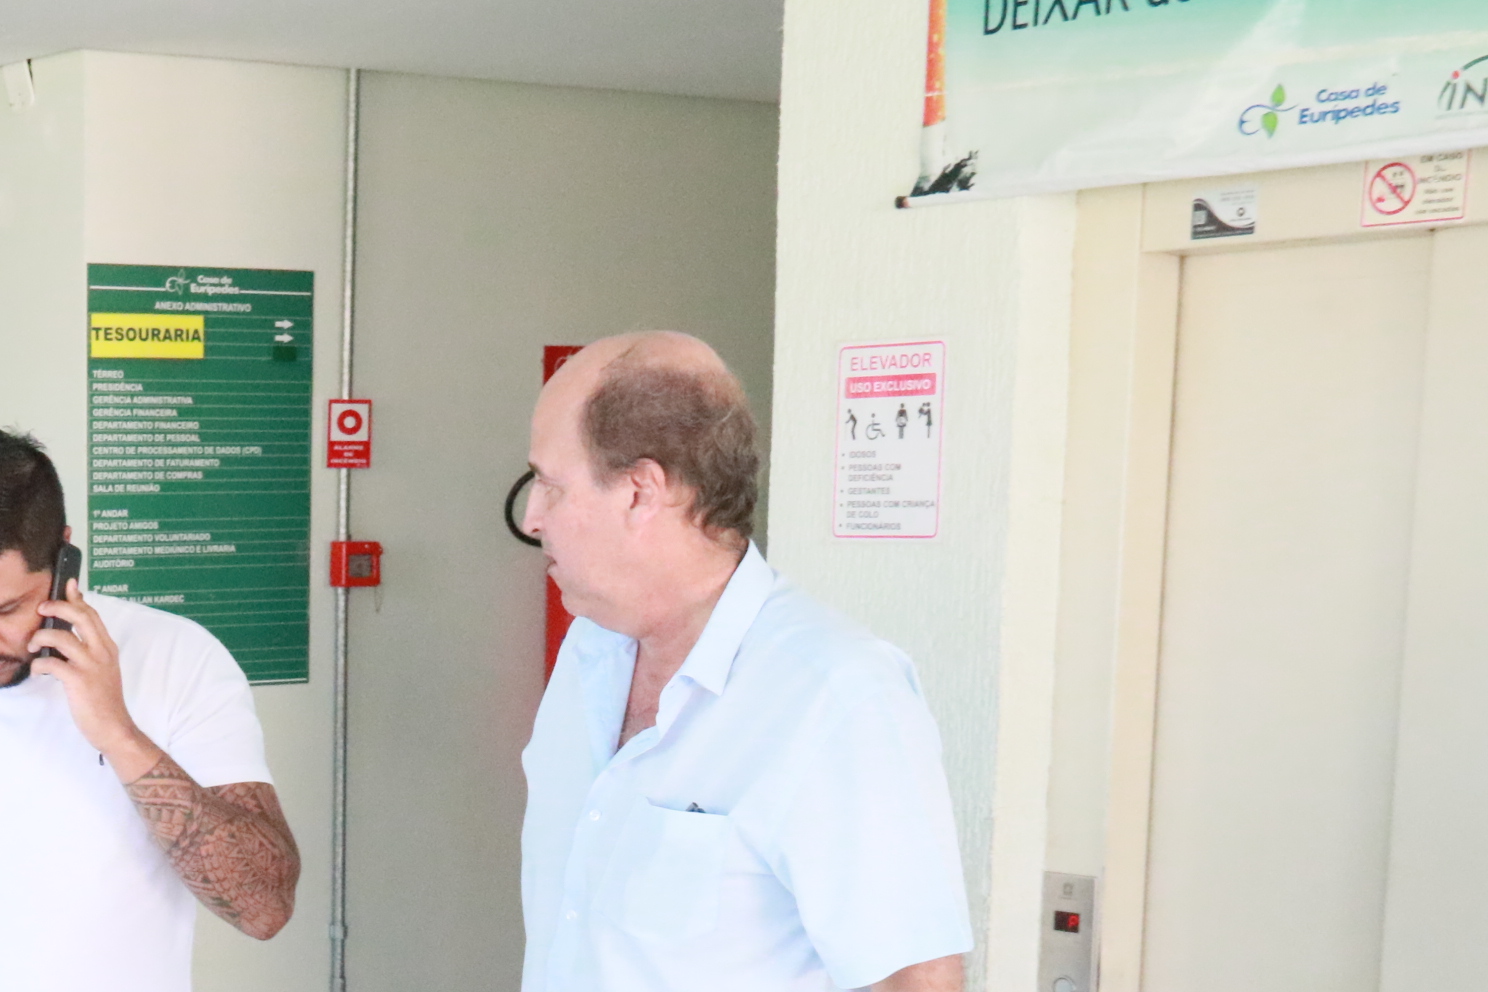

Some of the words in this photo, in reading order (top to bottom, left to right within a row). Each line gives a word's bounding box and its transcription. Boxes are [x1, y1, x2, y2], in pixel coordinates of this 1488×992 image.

[1315, 88, 1360, 104] Casa
[1364, 82, 1388, 97] de
[1298, 99, 1401, 125] Eurípedes
[197, 275, 219, 284] Casa
[220, 276, 233, 285] de
[154, 301, 183, 311] ANEXO
[185, 302, 252, 312] ADMINISTRATIVO
[91, 327, 202, 342] TESOURARIA
[850, 352, 932, 371] ELEVADOR
[93, 369, 124, 379] TÉRREO
[93, 382, 143, 391] PRESIDÊNCIA
[850, 382, 872, 393] USO
[873, 379, 932, 392] EXCLUSIVO
[93, 394, 132, 404] GERÊNCIA
[133, 396, 193, 404] ADMINISTRATIVA
[93, 407, 132, 417] GERÊNCIA
[133, 408, 178, 417] FINANCEIRA
[93, 421, 153, 429] DEPARTAMENTO
[154, 421, 200, 429] FINANCEIRO
[93, 434, 153, 442] DEPARTAMENTO
[154, 434, 165, 442] DE
[167, 434, 201, 442] PESSOAL
[93, 447, 124, 455] CENTRO
[125, 447, 136, 455] DE
[137, 447, 203, 455] PROCESSAMENTO
[204, 447, 214, 455] DE
[216, 447, 241, 455] DADOS
[93, 459, 153, 467] DEPARTAMENTO
[154, 459, 165, 467] DE
[166, 459, 220, 467] FATURAMENTO
[93, 472, 153, 480] DEPARTAMENTO
[154, 472, 165, 480] DE
[166, 471, 203, 479] COMPRAS
[93, 484, 114, 493] SALA
[126, 483, 160, 492] REUNIÃO
[101, 509, 129, 518] ANDAR
[93, 522, 128, 530] PROJETO
[129, 521, 159, 530] AMIGOS
[93, 534, 153, 543] DEPARTAMENTO
[154, 533, 211, 542] VOLUNTARIADO
[93, 546, 153, 556] DEPARTAMENTO
[202, 545, 236, 553] LIVRARIA
[93, 558, 135, 568] AUDITÓRIO
[101, 584, 129, 593] ANDAR
[154, 595, 185, 603] KARDEC
